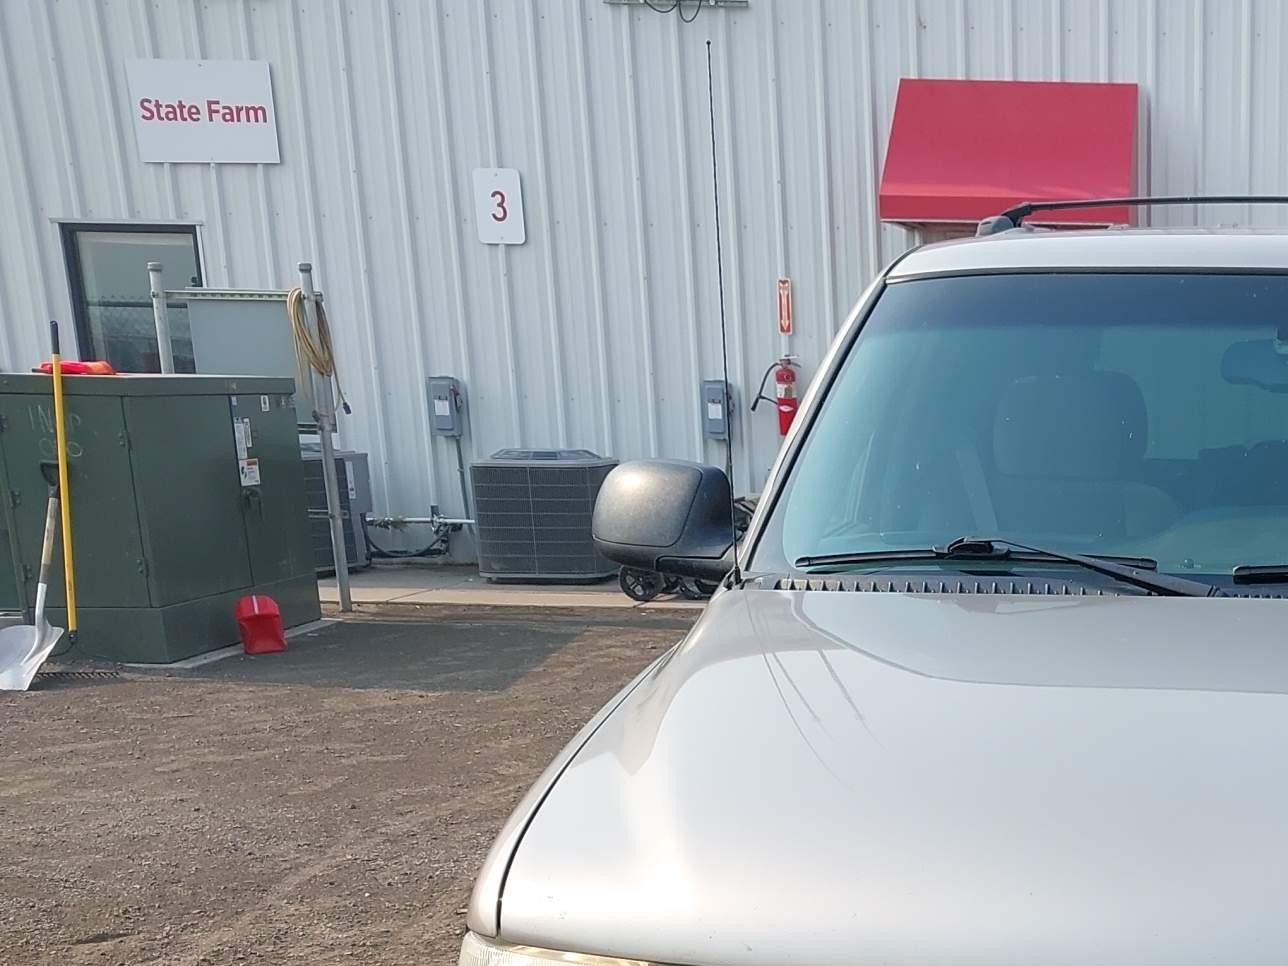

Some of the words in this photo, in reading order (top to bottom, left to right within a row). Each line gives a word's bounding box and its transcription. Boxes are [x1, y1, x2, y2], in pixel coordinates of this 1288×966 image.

[139, 98, 201, 122] State
[206, 99, 268, 123] Farm
[490, 190, 508, 222] 3
